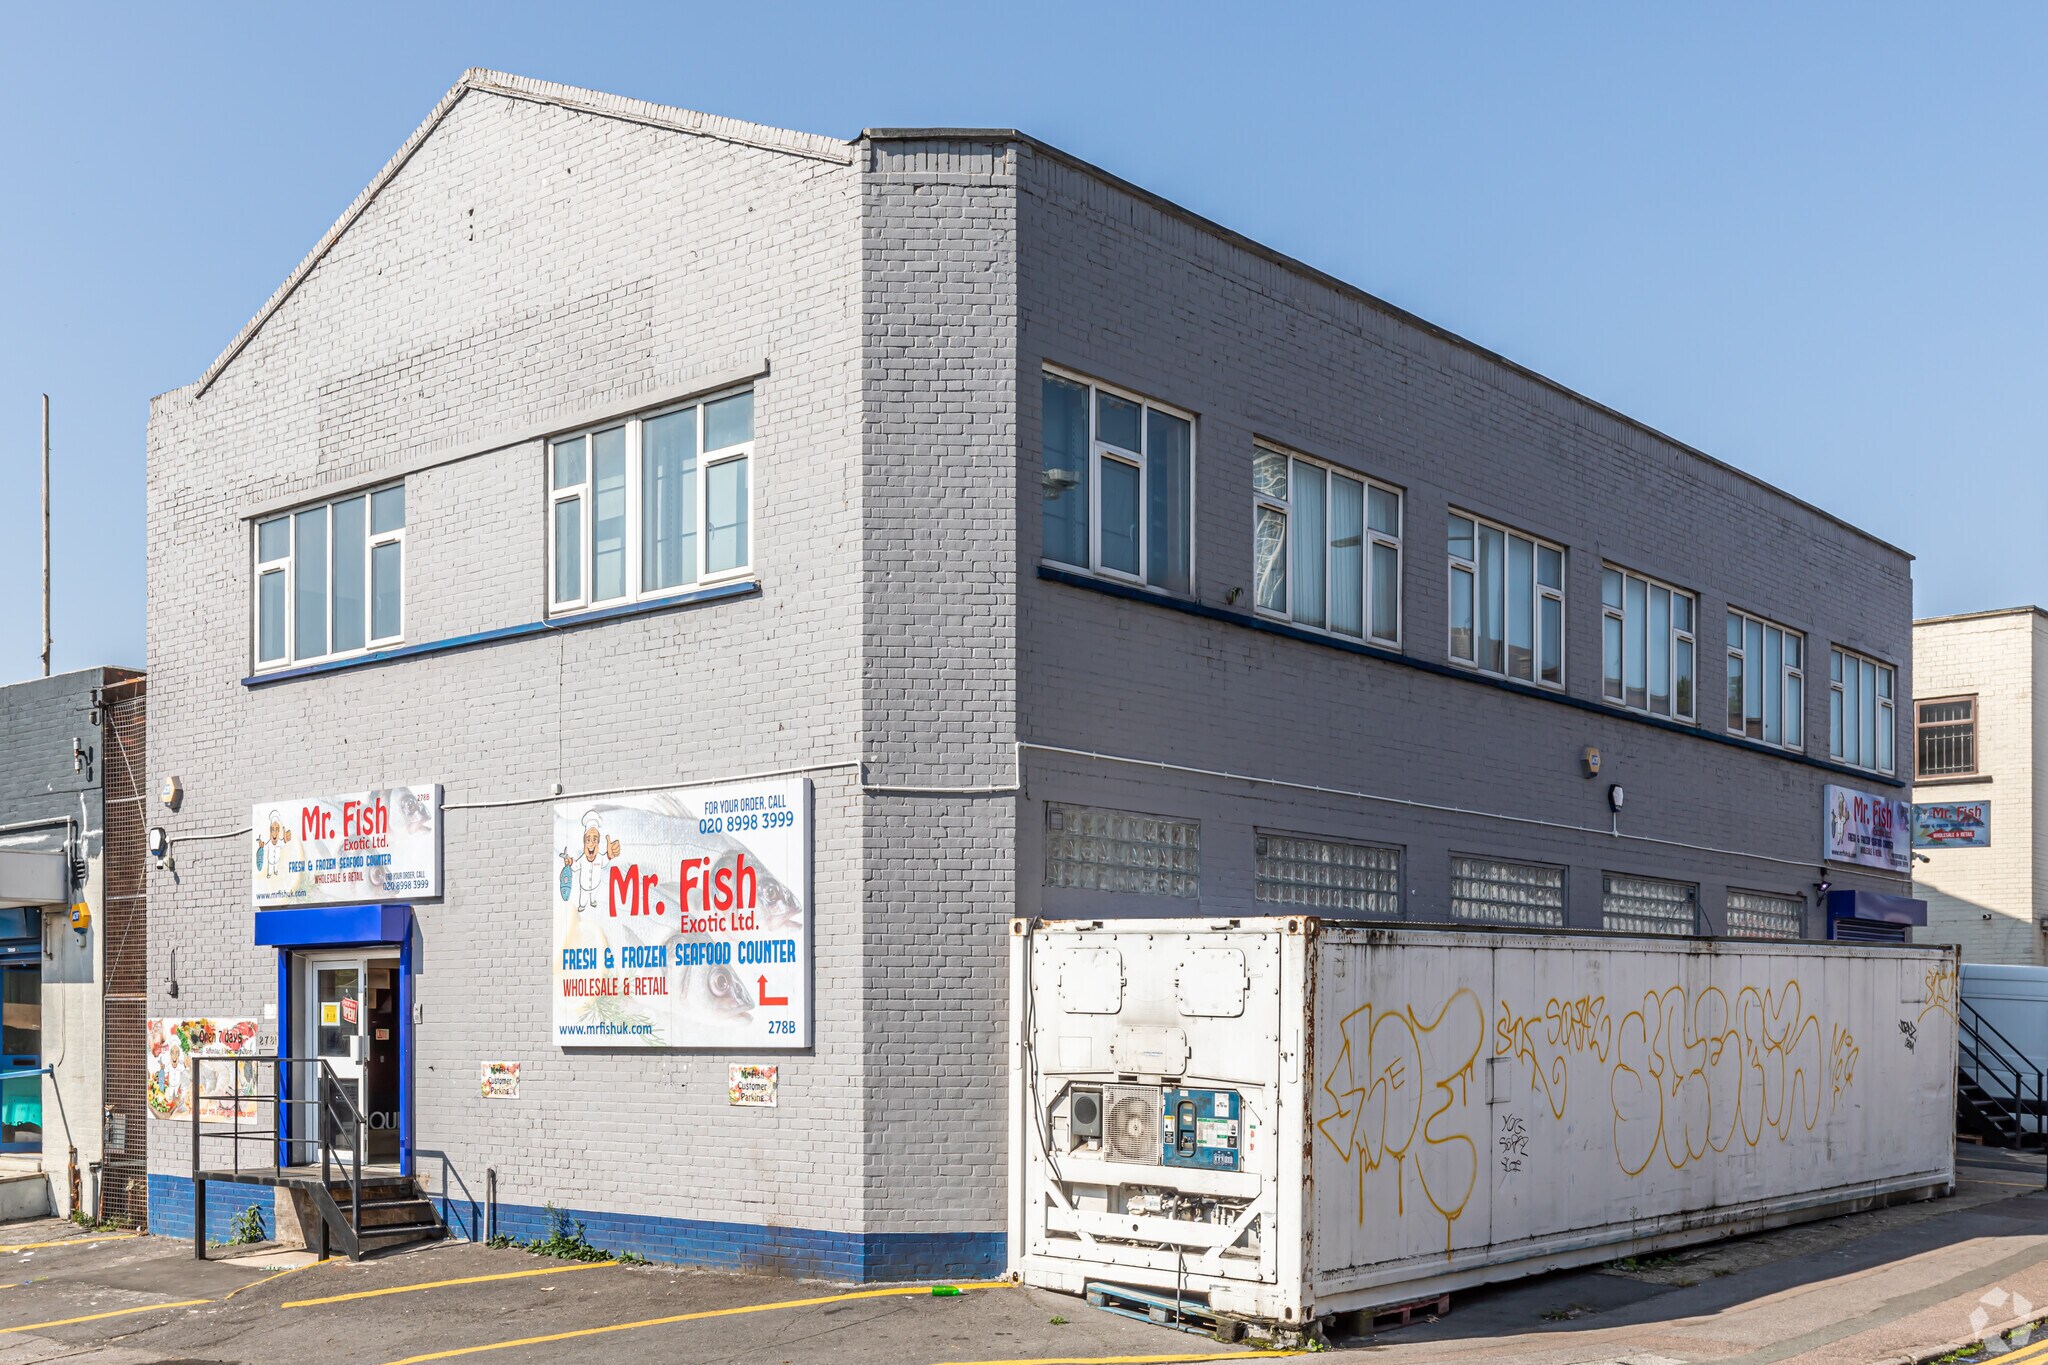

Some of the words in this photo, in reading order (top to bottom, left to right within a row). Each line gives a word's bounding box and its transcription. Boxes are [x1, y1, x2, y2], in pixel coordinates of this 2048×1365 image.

[704, 801, 718, 815] FOR
[720, 798, 739, 814] YOUR
[740, 796, 766, 812] ORDER,
[768, 794, 786, 809] CALL
[1854, 796, 1870, 825] Mr.
[1872, 800, 1892, 828] Fish
[302, 806, 335, 842] Mr.
[343, 798, 388, 838] Fish
[1932, 807, 1952, 819] Mr.
[1956, 806, 1982, 821] Fish
[700, 817, 723, 834] 020
[727, 814, 758, 832] 8998
[762, 810, 794, 828] 3999
[344, 836, 370, 851] Exotic
[372, 834, 389, 850] Ltd.
[289, 860, 306, 873] FRESH
[308, 860, 313, 872] &
[316, 858, 336, 870] FROZEN
[340, 856, 364, 869] SEAFOOD
[366, 853, 392, 867] COUNTER
[314, 872, 340, 884] WHOLESALE
[343, 872, 346, 882] &
[348, 872, 364, 882] RETAIL
[416, 870, 425, 878] CALL
[383, 882, 394, 890] 020
[396, 880, 411, 890] 8998
[413, 879, 429, 889] 3999
[608, 864, 666, 918] Mr.
[680, 854, 757, 912] Fish
[680, 914, 726, 934] Exotic
[731, 910, 760, 931] Ltd.
[562, 948, 597, 970] FRESH
[604, 947, 614, 969] &
[622, 945, 667, 968] FROZEN
[675, 941, 731, 966] SEAFOOD
[738, 939, 796, 964] COUNTER
[563, 977, 618, 997] WHOLESALE
[623, 977, 630, 996] &
[635, 976, 668, 996] RETAIL
[559, 1021, 652, 1036] www.mrfishuk.com
[768, 1020, 796, 1034] 278B
[199, 1030, 216, 1044] Open
[219, 1030, 223, 1043] 7
[224, 1029, 242, 1044] days
[488, 1076, 512, 1085] Customer
[738, 1081, 767, 1091] Customer
[491, 1086, 510, 1095] Parking
[741, 1093, 765, 1102] Parking
[369, 1111, 400, 1130] QU
